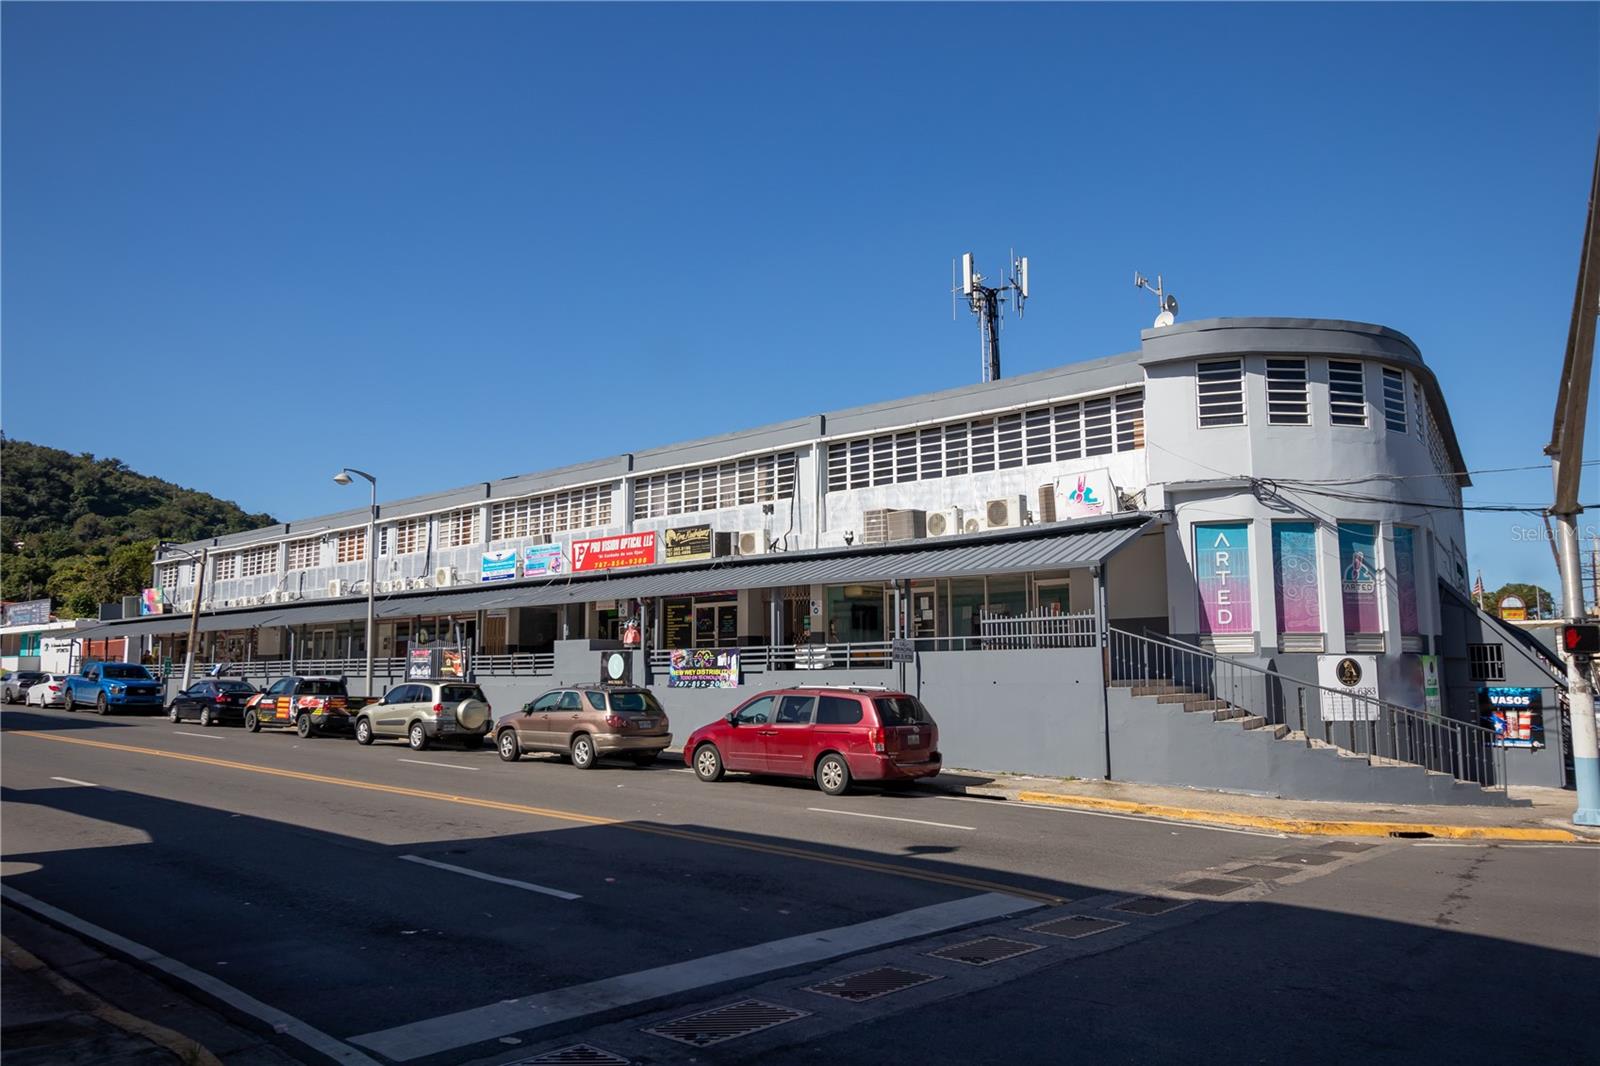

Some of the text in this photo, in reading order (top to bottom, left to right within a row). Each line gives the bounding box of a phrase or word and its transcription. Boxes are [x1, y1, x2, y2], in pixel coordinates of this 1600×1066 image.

[590, 534, 654, 553] PRO VISION OPTICAL LLC
[1214, 532, 1233, 625] ARTED
[1490, 696, 1530, 705] VASOS
